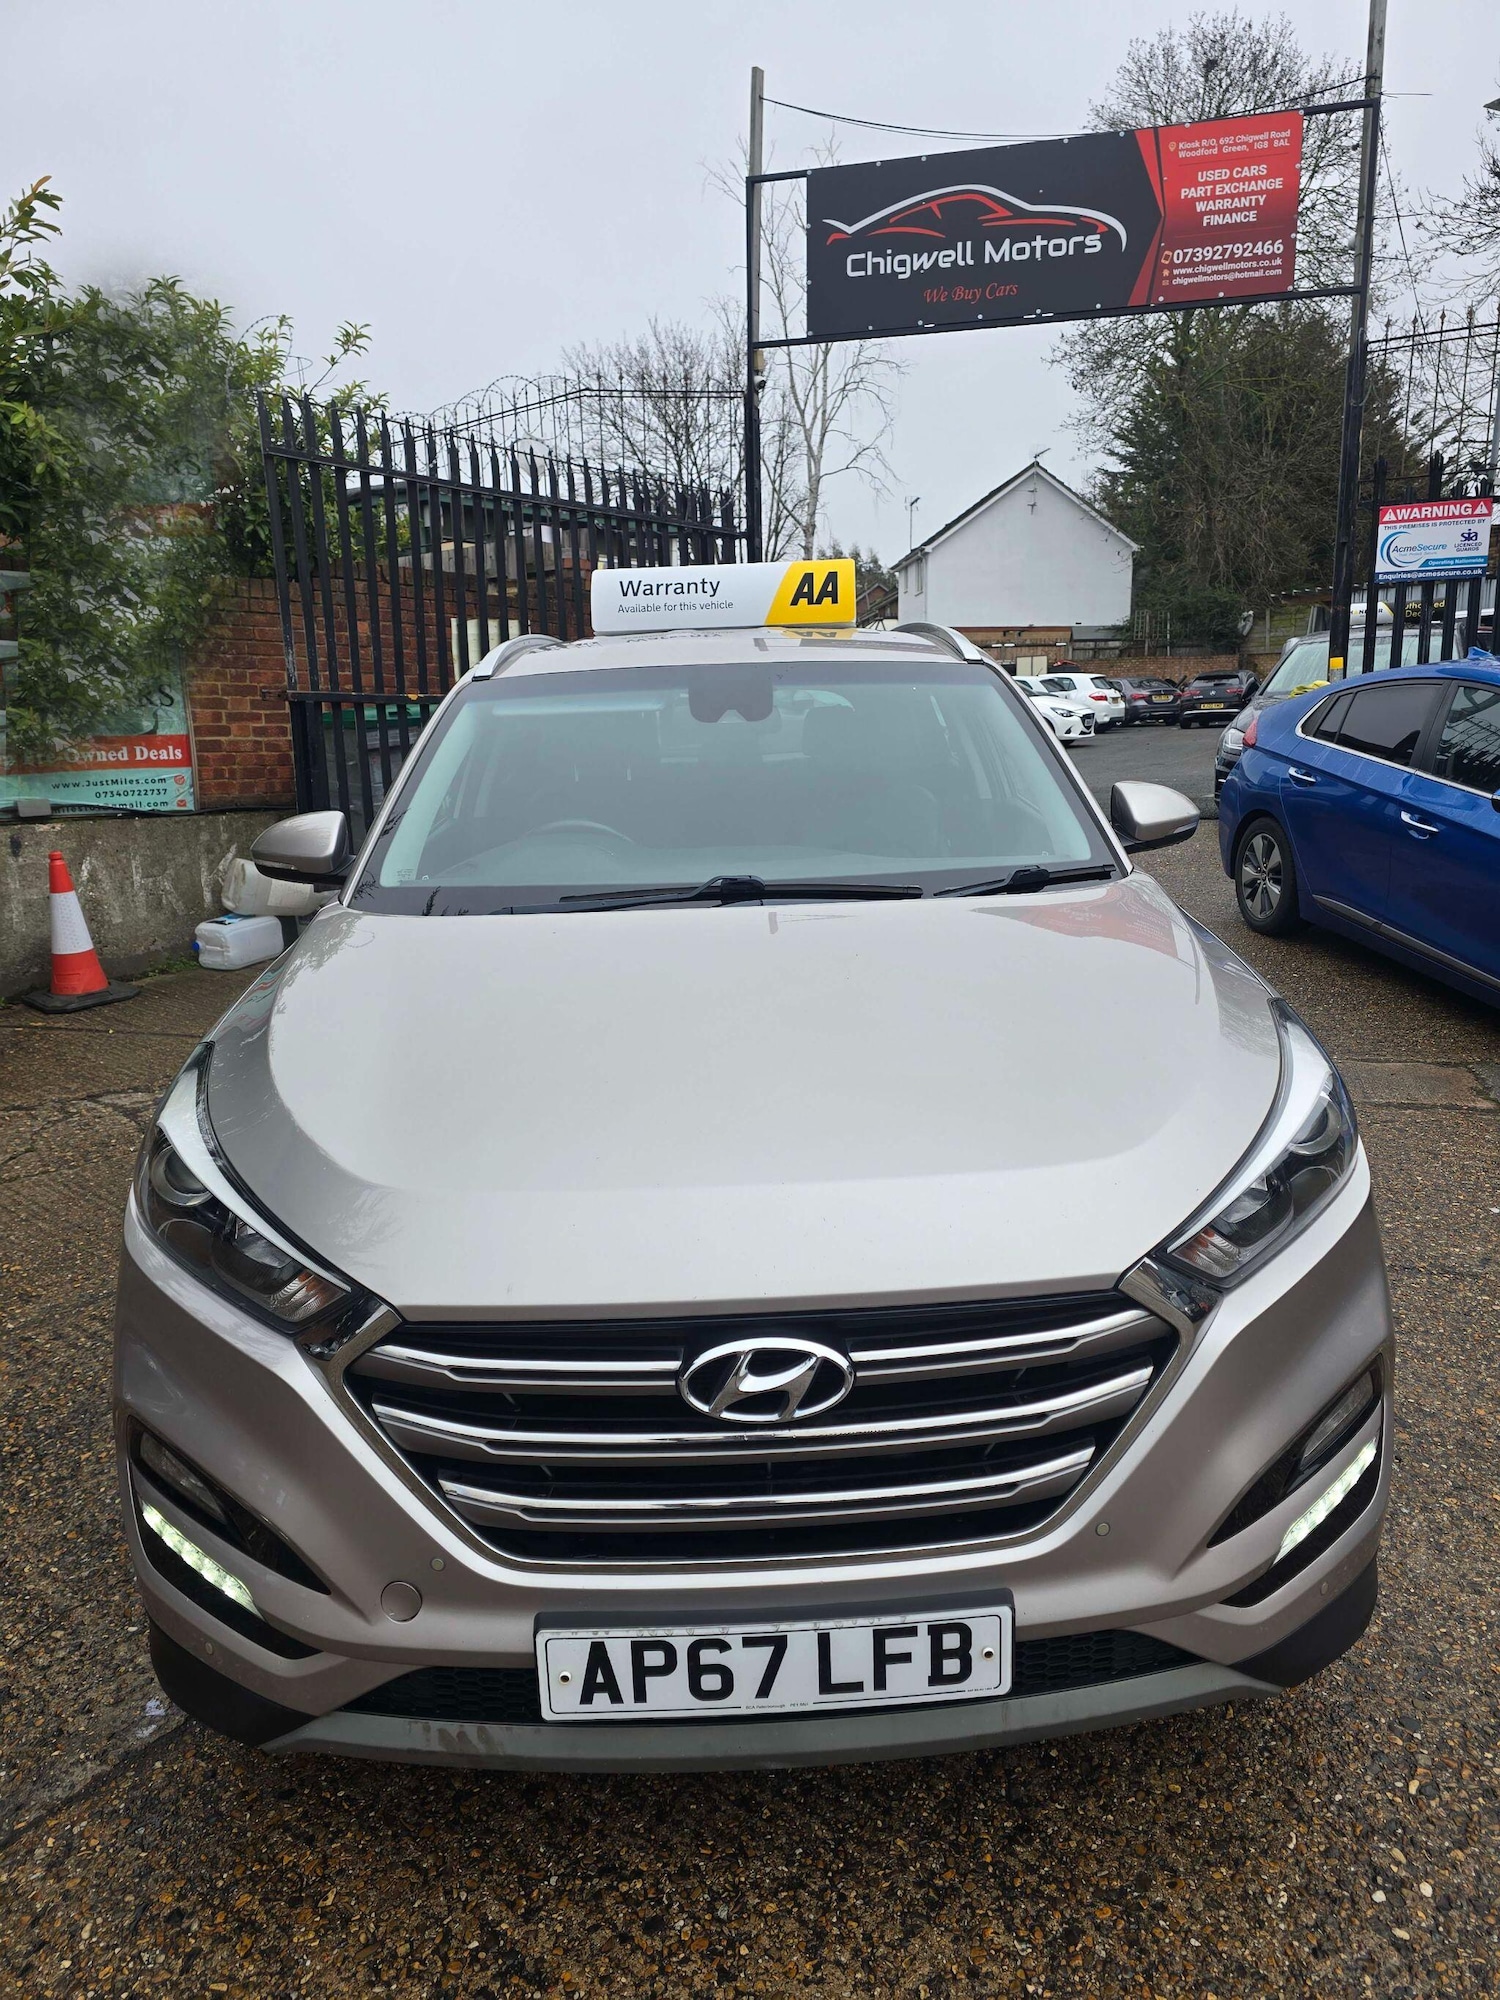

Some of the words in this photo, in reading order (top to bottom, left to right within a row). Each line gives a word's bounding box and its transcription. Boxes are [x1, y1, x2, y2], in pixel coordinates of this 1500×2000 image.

[1178, 140, 1200, 150] Kiosk
[1202, 139, 1218, 147] R/O,
[1219, 136, 1234, 145] 692
[1236, 131, 1268, 143] Chigwell
[1270, 129, 1290, 138] Road
[1178, 147, 1218, 158] Woodford
[1222, 145, 1249, 154] Green,
[1254, 141, 1268, 150] IG8
[1273, 139, 1290, 147] 8AL
[1197, 168, 1230, 182] USED
[1232, 164, 1268, 179] CARS
[1180, 185, 1213, 200] PART
[1215, 178, 1284, 196] EXCHANGE
[1196, 194, 1267, 212] WARRANTY
[1202, 210, 1258, 227] FINANCE
[846, 240, 975, 280] Chigwell
[984, 234, 1103, 264] Motors
[1173, 239, 1284, 264] 07392792466
[1172, 257, 1282, 275] www.chigwellmotors.co.uk
[1172, 268, 1282, 286] chigwellmotors@hotmail.com
[924, 285, 948, 303] We
[952, 285, 982, 305] Buy
[986, 282, 1019, 298] Cars
[1396, 503, 1472, 520] WARNING
[1399, 522, 1430, 530] PREMISES
[1460, 528, 1478, 542] sia
[1392, 543, 1448, 554] AcmeSecure
[1378, 568, 1482, 580] Enquiries@acmesecure.co.uk
[619, 577, 721, 598] Warranty
[790, 571, 838, 607] AA
[618, 603, 662, 614] Available
[664, 602, 677, 612] for
[679, 602, 697, 611] this
[699, 600, 734, 610] vehicle
[134, 745, 183, 761] Deals
[51, 776, 168, 790] www.JustMiles.com
[94, 788, 168, 799] 07340722737
[578, 1634, 788, 1706] AP67
[818, 1622, 973, 1695] LFB
